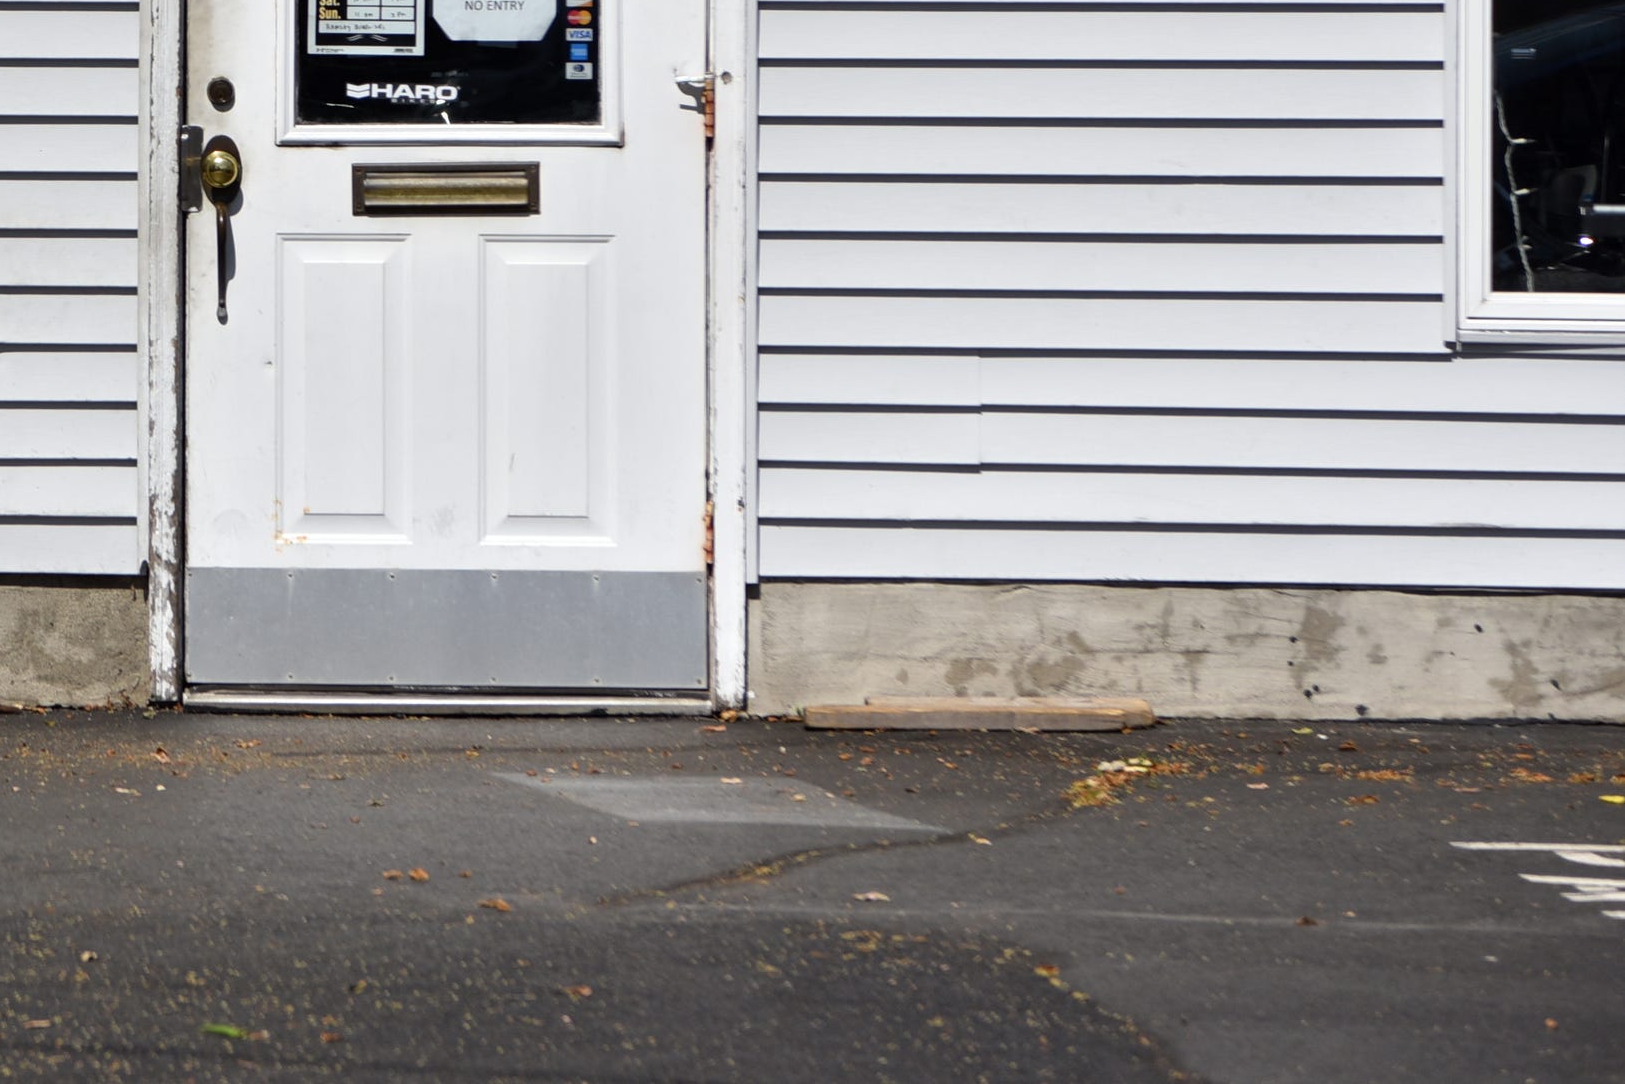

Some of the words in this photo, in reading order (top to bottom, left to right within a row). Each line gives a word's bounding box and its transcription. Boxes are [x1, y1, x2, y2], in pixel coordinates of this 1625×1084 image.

[465, 0, 484, 11] NO
[487, 0, 525, 11] ENTRY
[319, 7, 341, 19] Sun.
[569, 30, 591, 39] VISA
[371, 83, 458, 101] HARO
